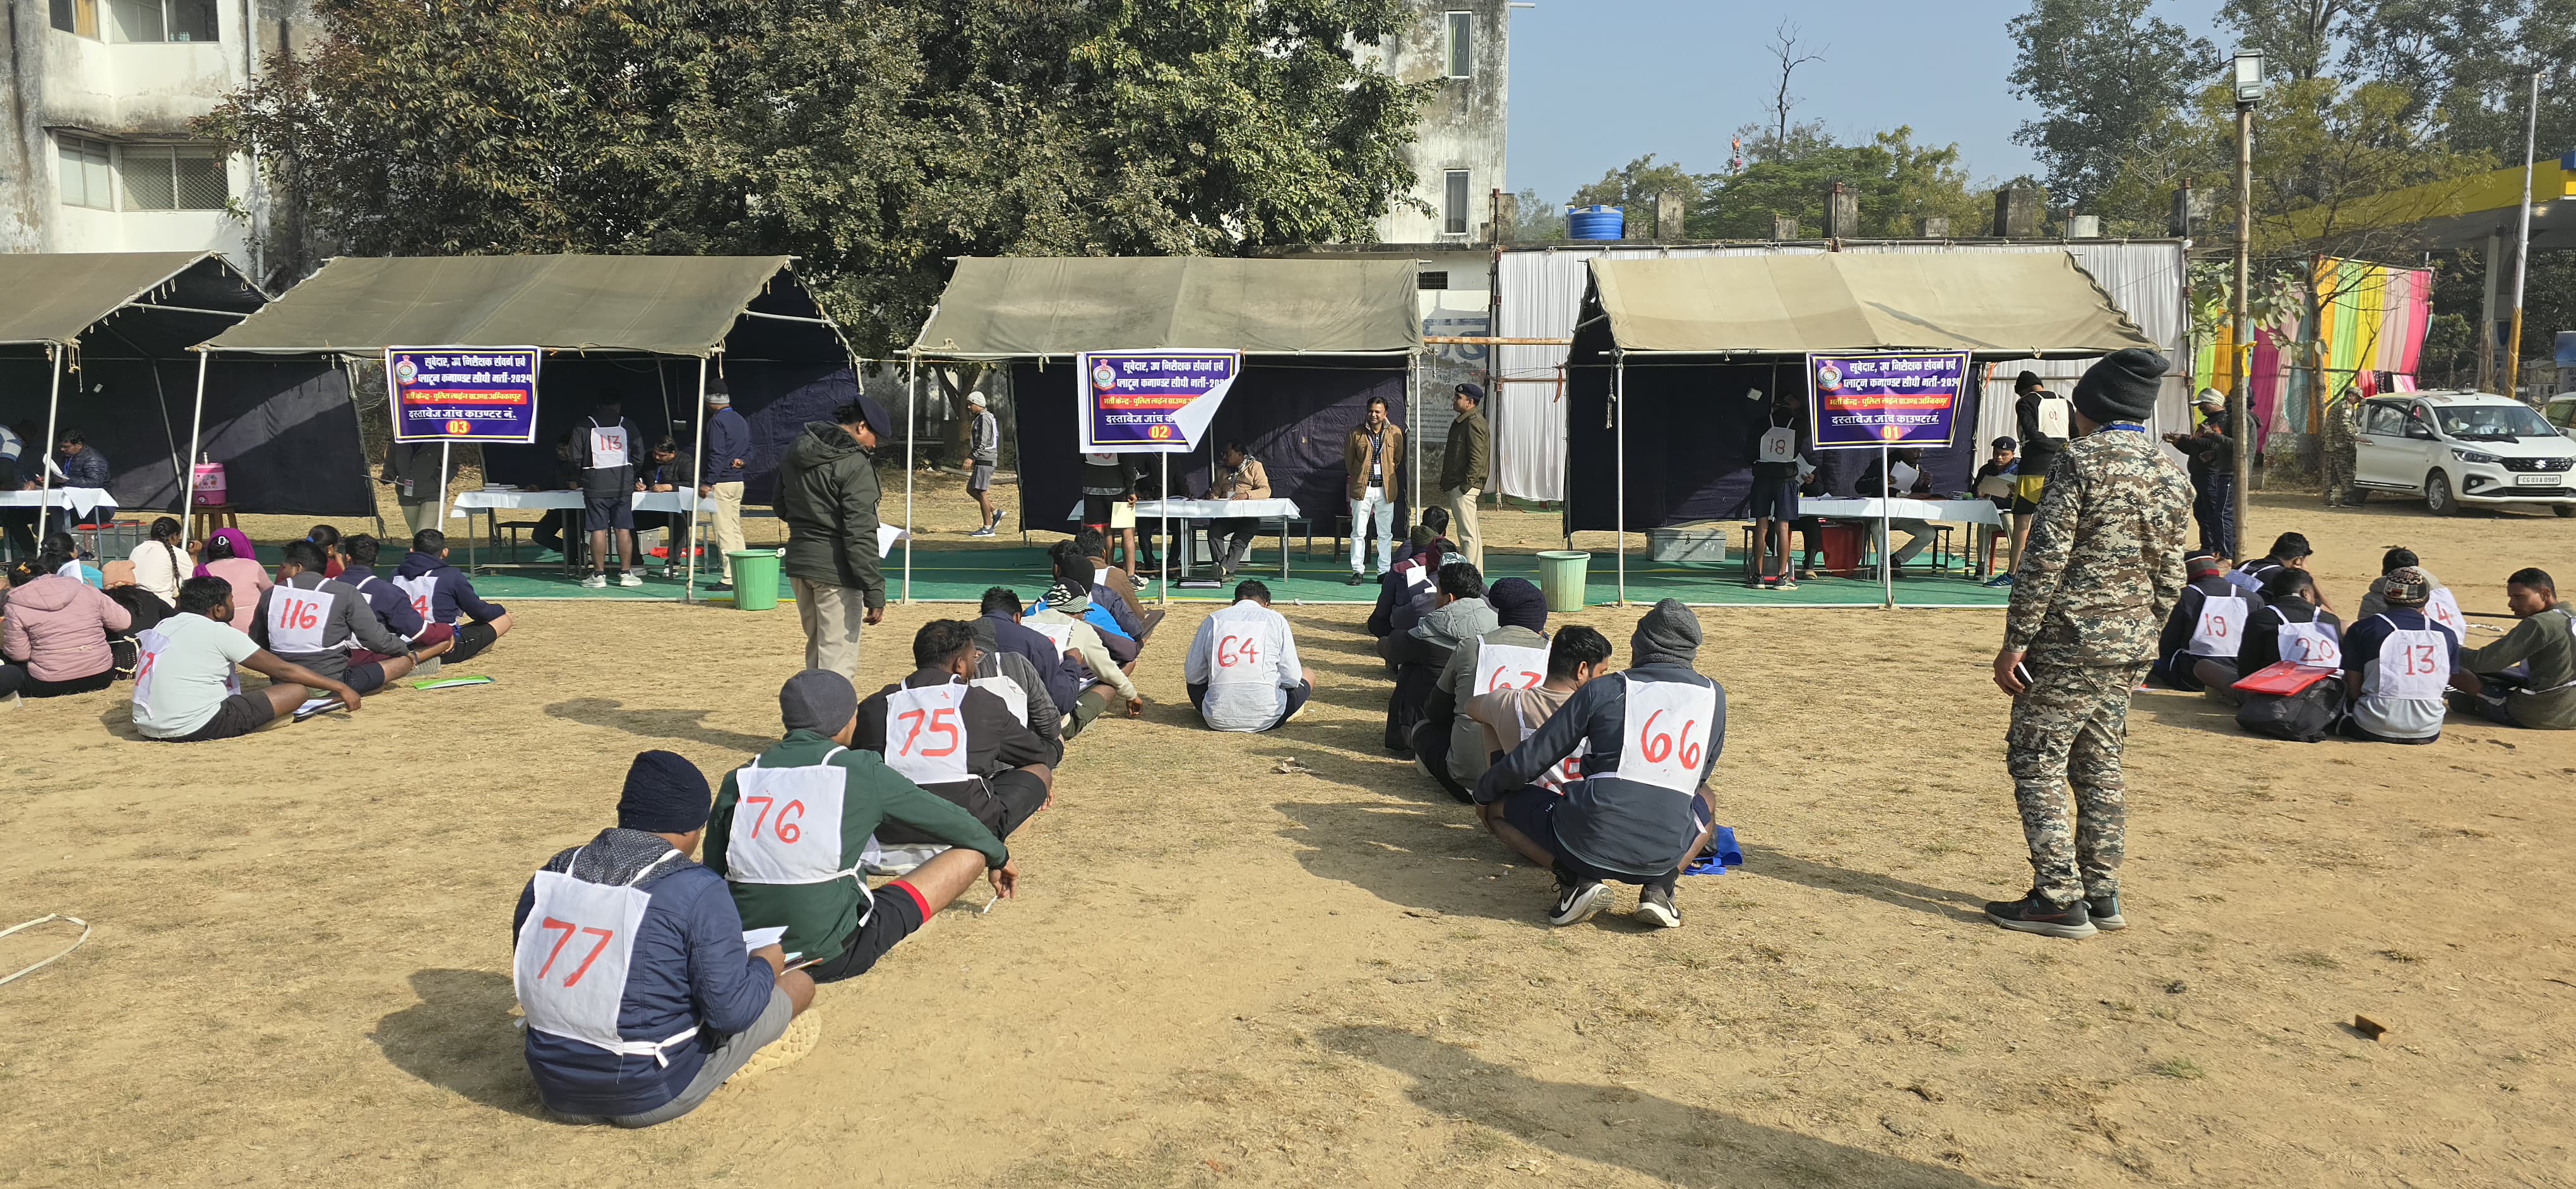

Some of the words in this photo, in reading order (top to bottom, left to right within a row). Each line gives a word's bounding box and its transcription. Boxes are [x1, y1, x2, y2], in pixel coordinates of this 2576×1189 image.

[424, 355, 450, 369] सूबेदार,
[451, 357, 462, 366] उप
[462, 355, 493, 366] निरीक्षक
[494, 355, 513, 366] संवर्ग
[515, 355, 526, 366] एवं
[1123, 359, 1148, 374] सूबेदार,
[1150, 362, 1160, 371] उप
[1162, 359, 1192, 371] निरीक्षक
[1193, 359, 1212, 371] संवर्ग
[1213, 359, 1224, 371] एवं
[1849, 361, 1877, 374] सूबेदार,
[1879, 362, 1890, 371] उप
[1891, 359, 1923, 371] निरीक्षक
[1923, 359, 1944, 370] संवर्ग
[1945, 358, 1957, 370] एवं
[417, 374, 441, 386] प्लाटून
[441, 374, 472, 383] कमाण्डर
[1116, 379, 1139, 391] प्लाटून
[1140, 378, 1171, 388] कमाण्डर
[1844, 379, 1868, 391] प्लाटून
[1869, 378, 1901, 387] कमाण्डर
[434, 391, 450, 402] पुलिस
[488, 391, 522, 402] अम्बिकापुर
[1104, 396, 1114, 404] भर्ती
[1133, 396, 1150, 407] पुलिस
[1151, 396, 1167, 405] लाईन
[1862, 397, 1881, 407] पुलिस
[408, 407, 442, 419] दस्तावेज
[442, 407, 463, 417] जांच
[464, 410, 502, 418] काउण्टर
[503, 407, 516, 418] नं.
[1106, 412, 1143, 423] दस्तावेज
[1143, 412, 1163, 422] जांच
[1831, 412, 1873, 425] दस्तावेज
[1874, 411, 1895, 423] जांच
[1896, 415, 1931, 423] काउण्टर
[2049, 410, 2058, 420] 01
[449, 421, 467, 433] 03
[1151, 426, 1168, 438] 02
[1884, 426, 1899, 439] 01
[600, 434, 622, 450] 113
[1770, 438, 1786, 455] 18
[280, 598, 318, 630] 116
[2205, 612, 2226, 637] 19
[1218, 635, 1259, 667] 64
[2295, 638, 2334, 662] 20
[2404, 645, 2435, 676] 13
[898, 708, 958, 756] 75
[1641, 709, 1700, 770] 66
[737, 796, 805, 844] 76
[538, 916, 614, 988] 77
